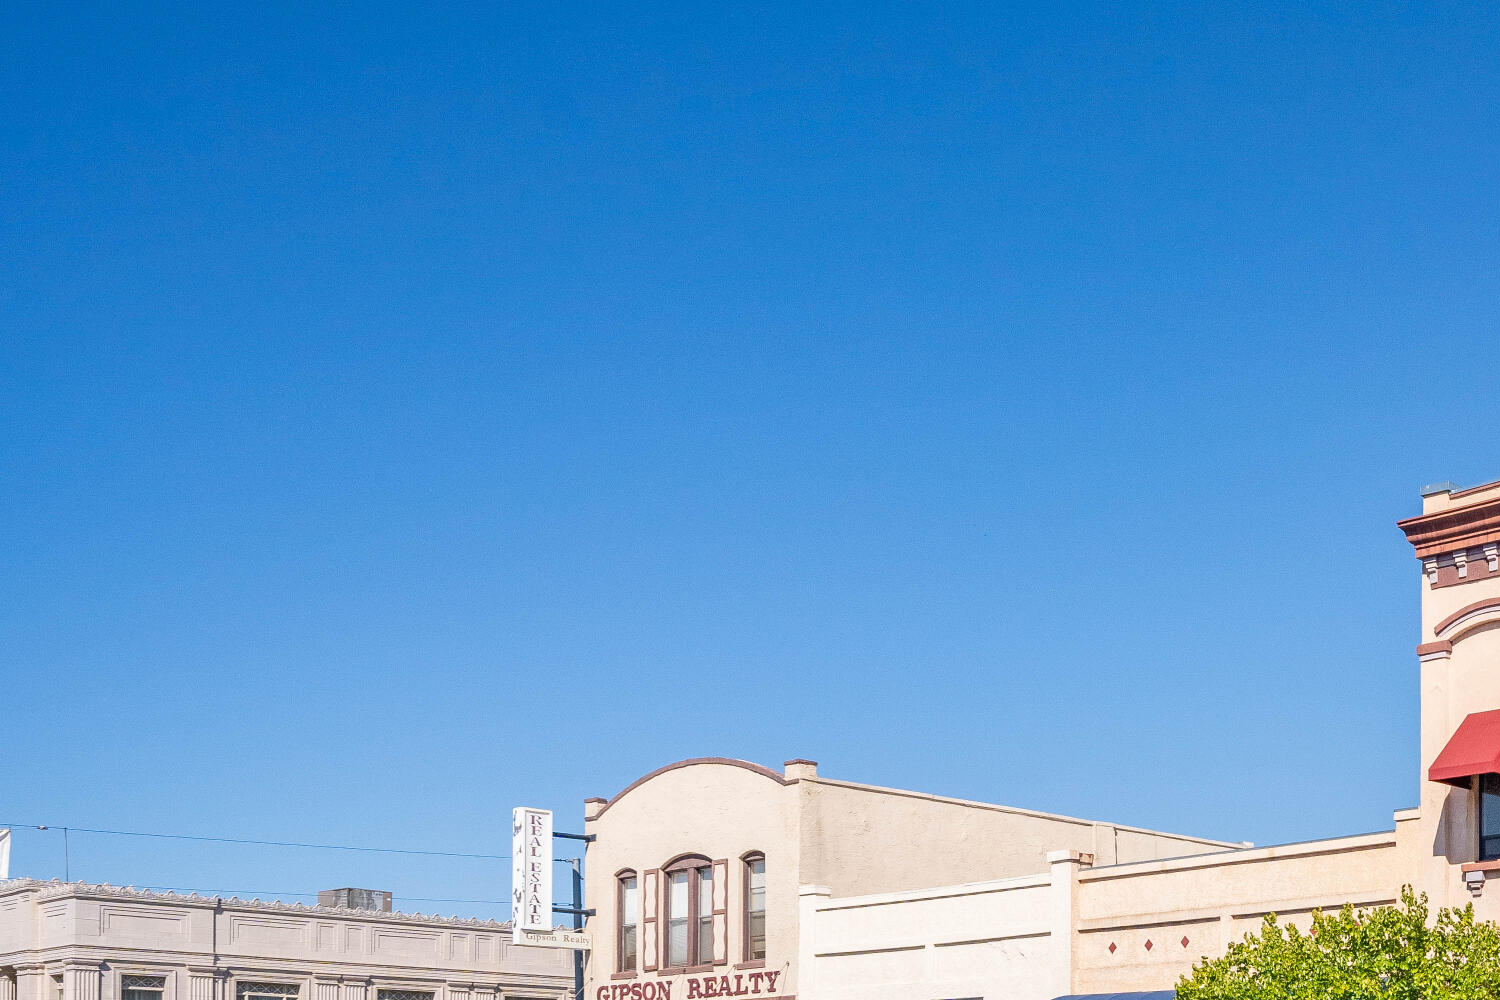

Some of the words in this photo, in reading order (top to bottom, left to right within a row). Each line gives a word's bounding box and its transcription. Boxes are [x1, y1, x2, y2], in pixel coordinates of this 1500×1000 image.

[530, 815, 543, 858] REAL
[530, 862, 542, 925] ESTATE
[525, 932, 557, 944] Gipson
[563, 934, 590, 945] Realty
[686, 971, 781, 1000] REALTY
